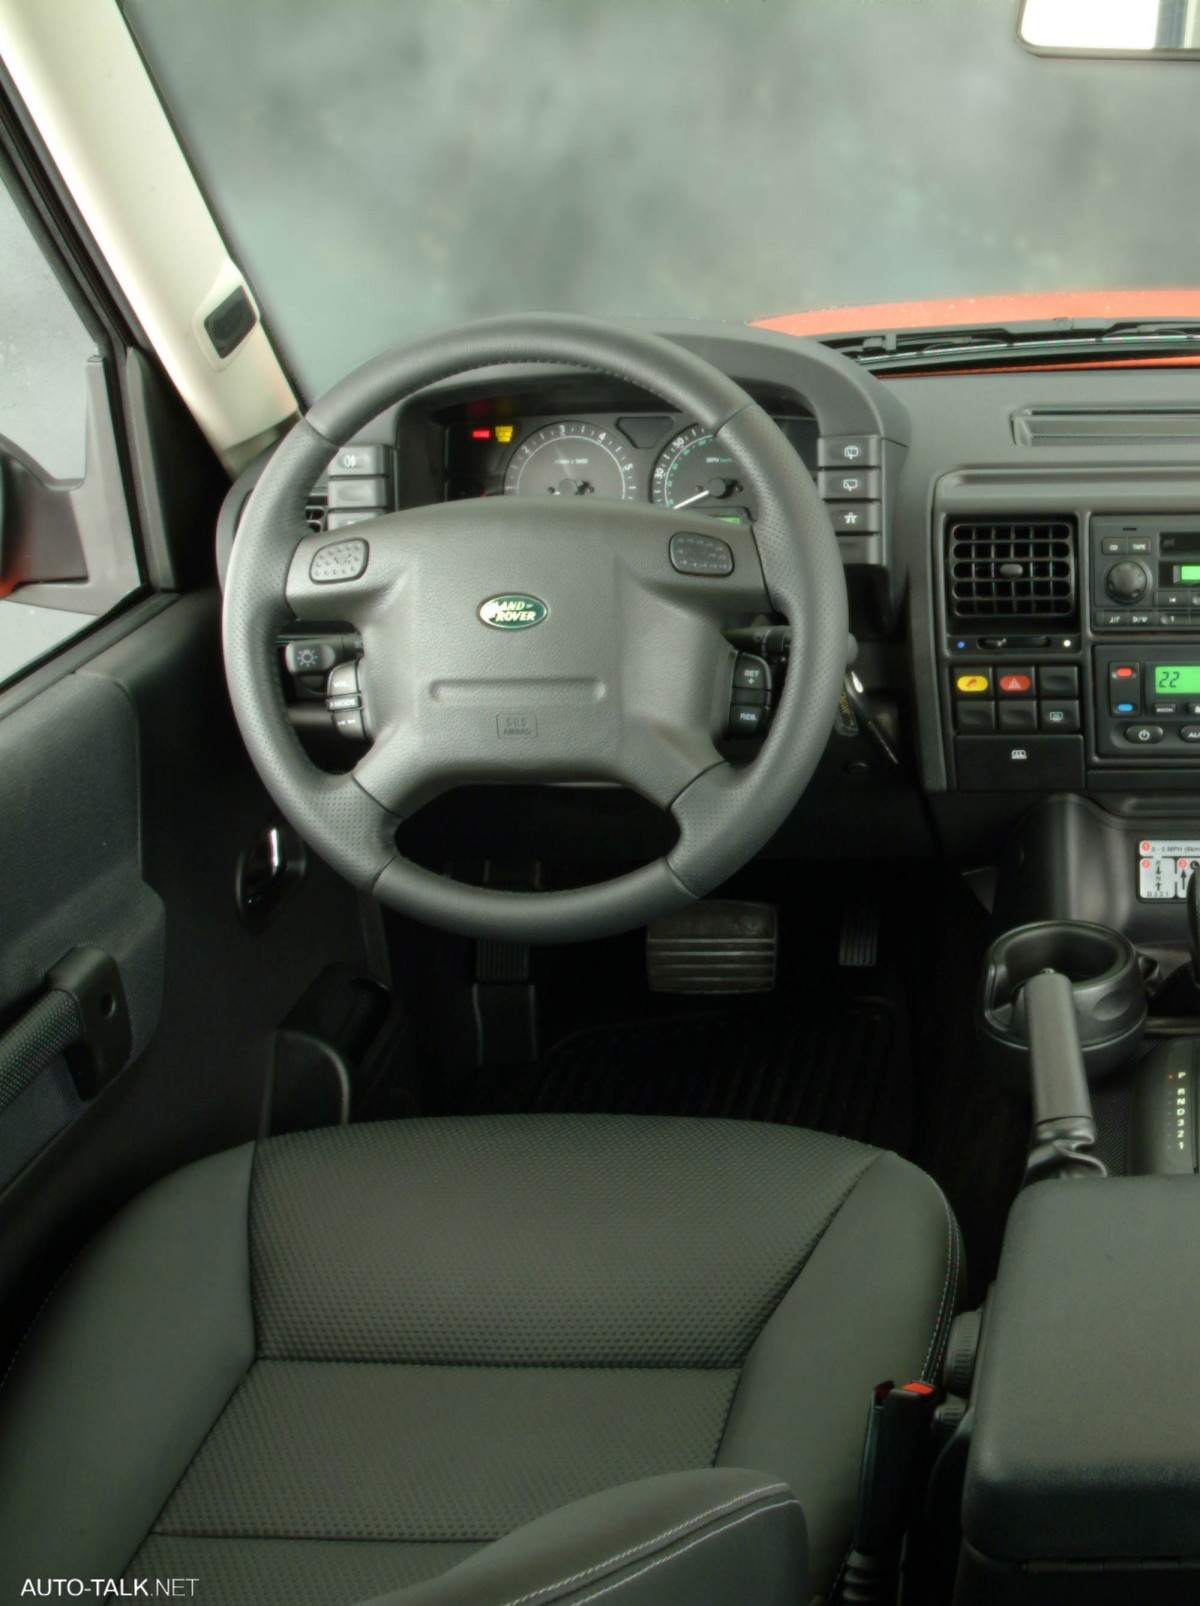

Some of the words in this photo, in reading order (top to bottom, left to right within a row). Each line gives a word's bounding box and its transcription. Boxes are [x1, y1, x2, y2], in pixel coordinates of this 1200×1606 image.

[558, 424, 566, 434] 3
[598, 431, 607, 441] 4
[673, 437, 685, 448] 50
[521, 445, 531, 454] 2
[654, 468, 664, 479] 30
[495, 611, 537, 622] ROVER
[743, 669, 760, 678] SET
[1158, 671, 1180, 688] 22
[1178, 1119, 1184, 1127] 3
[1178, 1130, 1184, 1138] 2
